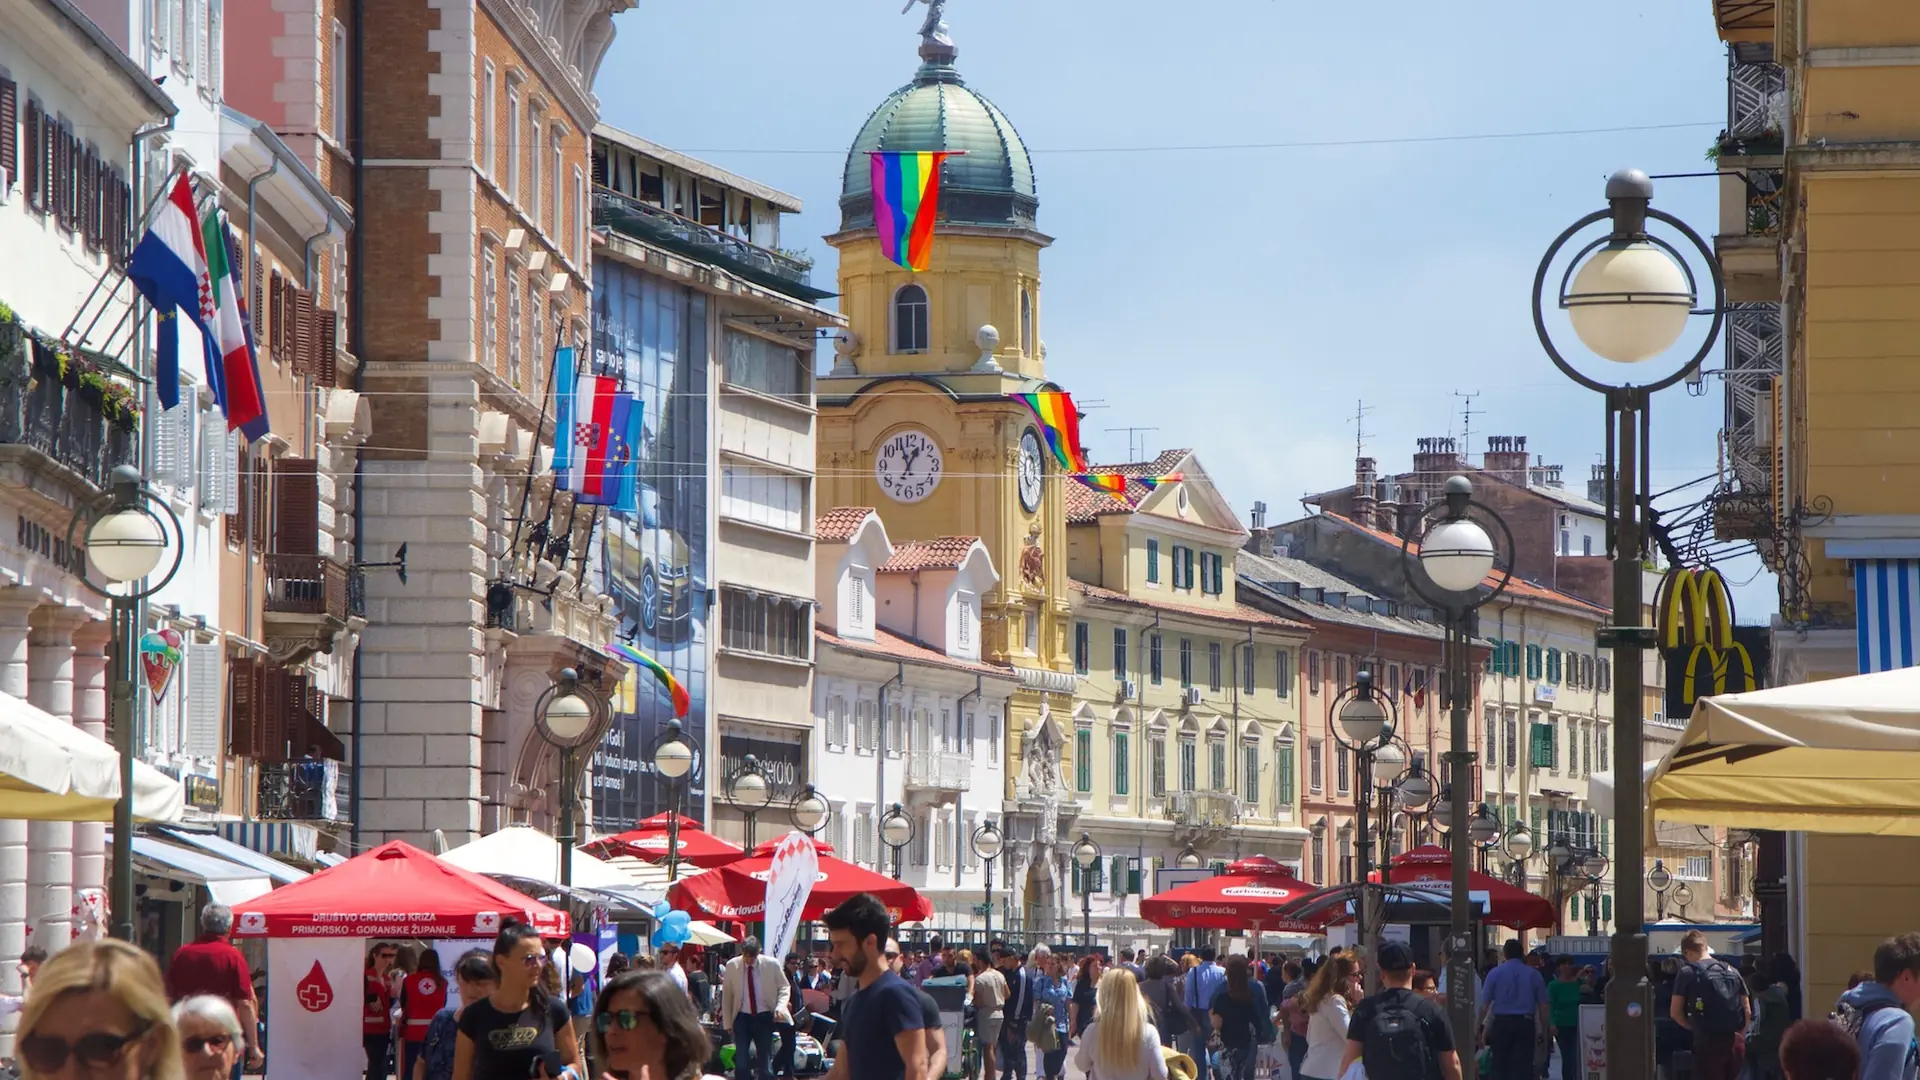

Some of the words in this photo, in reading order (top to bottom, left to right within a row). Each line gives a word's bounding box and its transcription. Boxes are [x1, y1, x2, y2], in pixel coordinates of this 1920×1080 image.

[905, 434, 917, 448] 12
[920, 438, 925, 451] 1
[883, 445, 895, 458] 10
[926, 444, 934, 458] 2
[878, 459, 888, 473] 9
[931, 458, 939, 472] 3
[883, 474, 893, 488] 8
[924, 472, 934, 486] 4
[895, 483, 903, 497] 7
[904, 485, 913, 500] 6
[916, 482, 925, 496] 5
[312, 911, 357, 922] DRUŠTVO
[359, 912, 406, 922] CRVENOG
[407, 912, 437, 922] KRIZA
[291, 925, 349, 935] PRIMORSKO
[356, 925, 409, 935] GORANSKE
[411, 923, 457, 935] ŽUPANIJE
